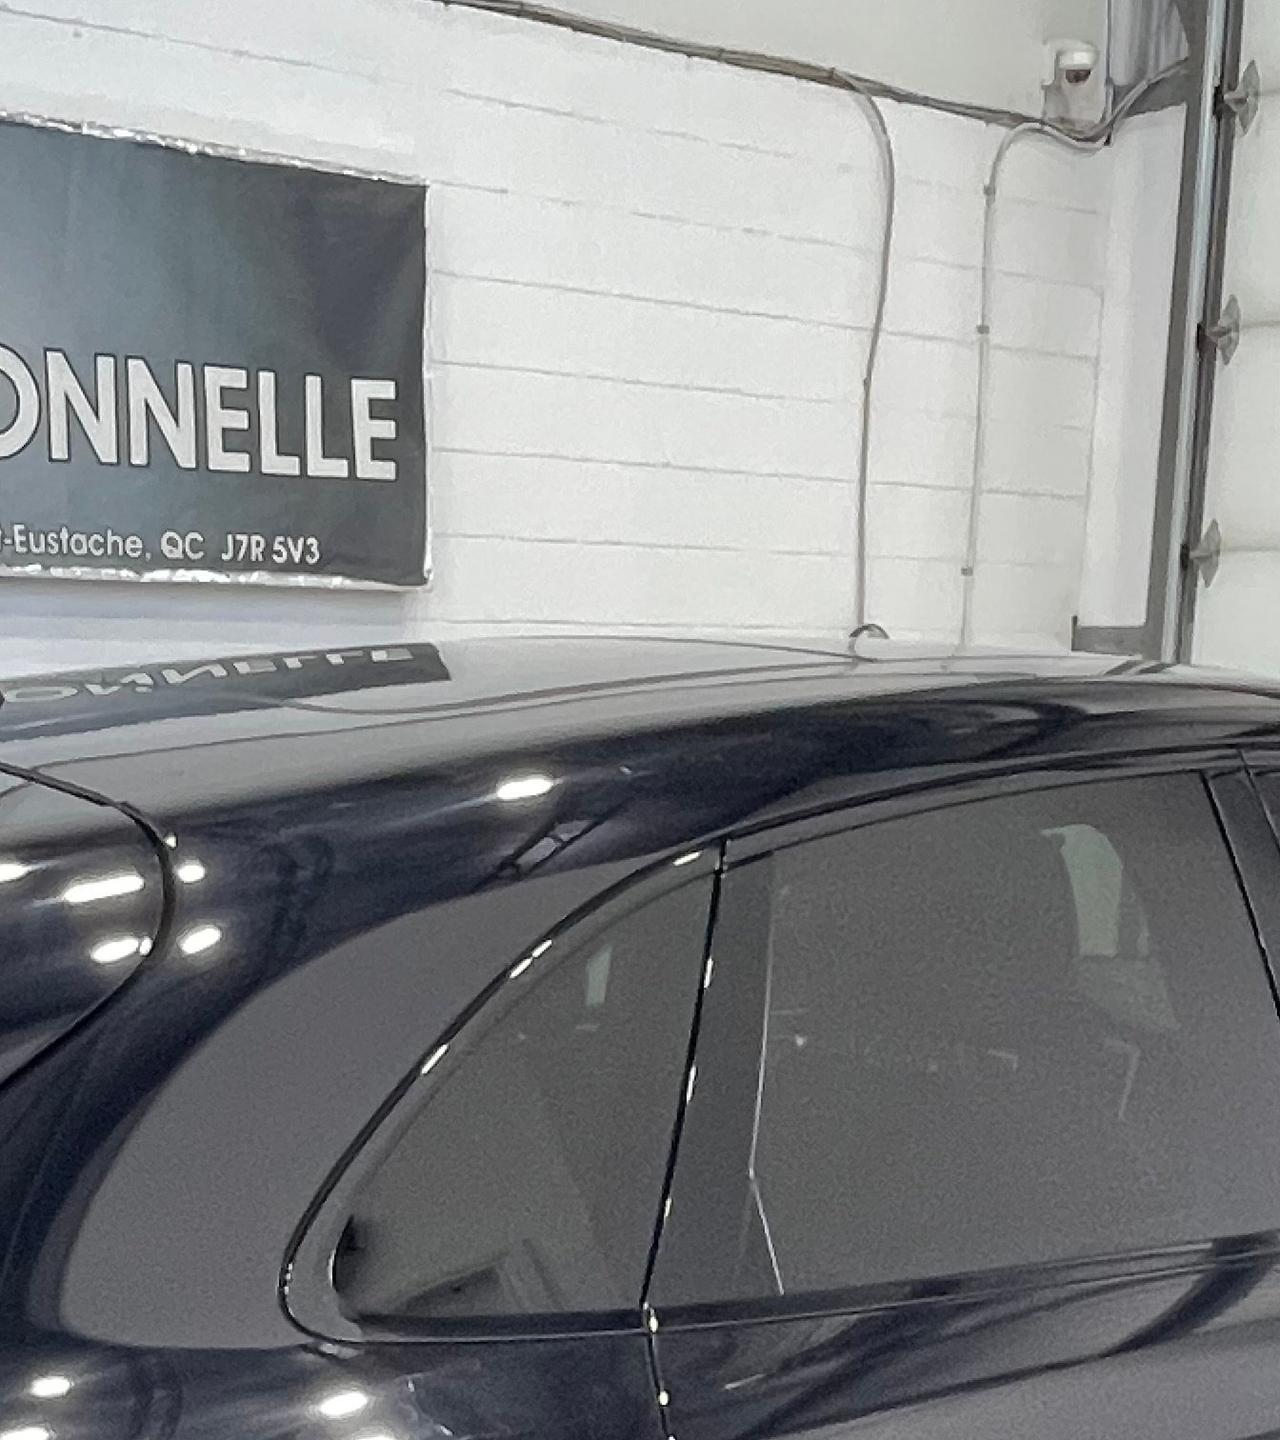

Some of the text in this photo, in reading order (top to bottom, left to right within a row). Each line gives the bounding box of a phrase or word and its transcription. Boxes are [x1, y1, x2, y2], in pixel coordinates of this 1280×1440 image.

[160, 529, 206, 561] QC
[220, 533, 266, 563] J7R
[271, 535, 321, 566] 5V3
